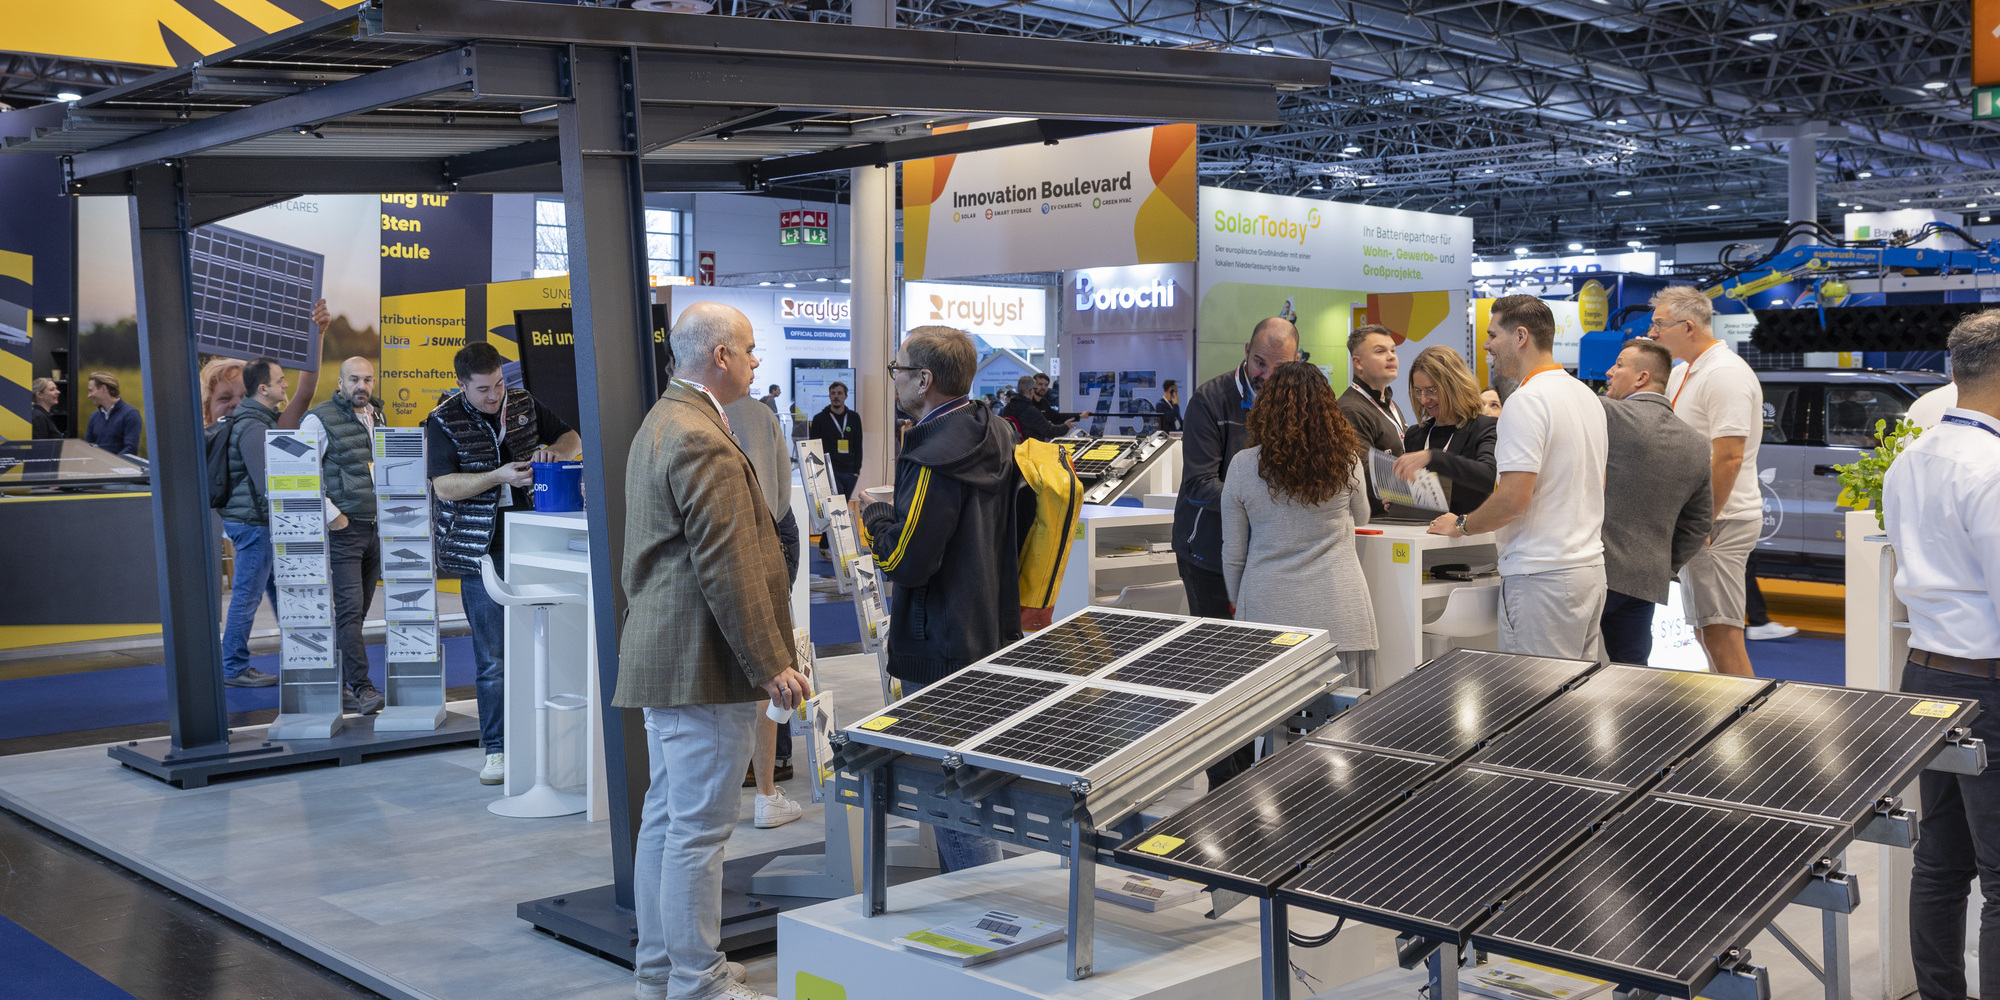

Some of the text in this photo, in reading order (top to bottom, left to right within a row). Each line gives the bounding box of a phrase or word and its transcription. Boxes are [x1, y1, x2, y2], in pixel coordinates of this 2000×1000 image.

[953, 171, 1132, 208] Innovation Boulevard
[286, 201, 318, 214] CARES
[994, 207, 1032, 217] SMART STORAGE
[1057, 202, 1082, 210] CHARGING
[1214, 209, 1307, 245] SolarToday
[1363, 225, 1452, 245] Ihr Batteriepartner für
[1215, 244, 1225, 253] Der
[1225, 246, 1257, 256] europäische
[1258, 248, 1289, 258] Großhändler
[1289, 251, 1298, 259] mit
[1363, 245, 1455, 264] Wohn-, Gewerbe- und
[1813, 250, 1877, 261] sunbrush Eagle
[1214, 259, 1234, 267] lokalen
[1234, 260, 1271, 272] Niederlassung
[1287, 264, 1300, 273] Nähe
[1363, 264, 1423, 281] Großprojekte.
[1076, 272, 1175, 311] Borochi
[948, 294, 1024, 327] raylyst
[384, 335, 410, 345] Libra
[532, 329, 552, 346] Bei
[380, 368, 457, 379] nerschaften:
[392, 401, 417, 409] Holland
[1396, 548, 1406, 558] bk
